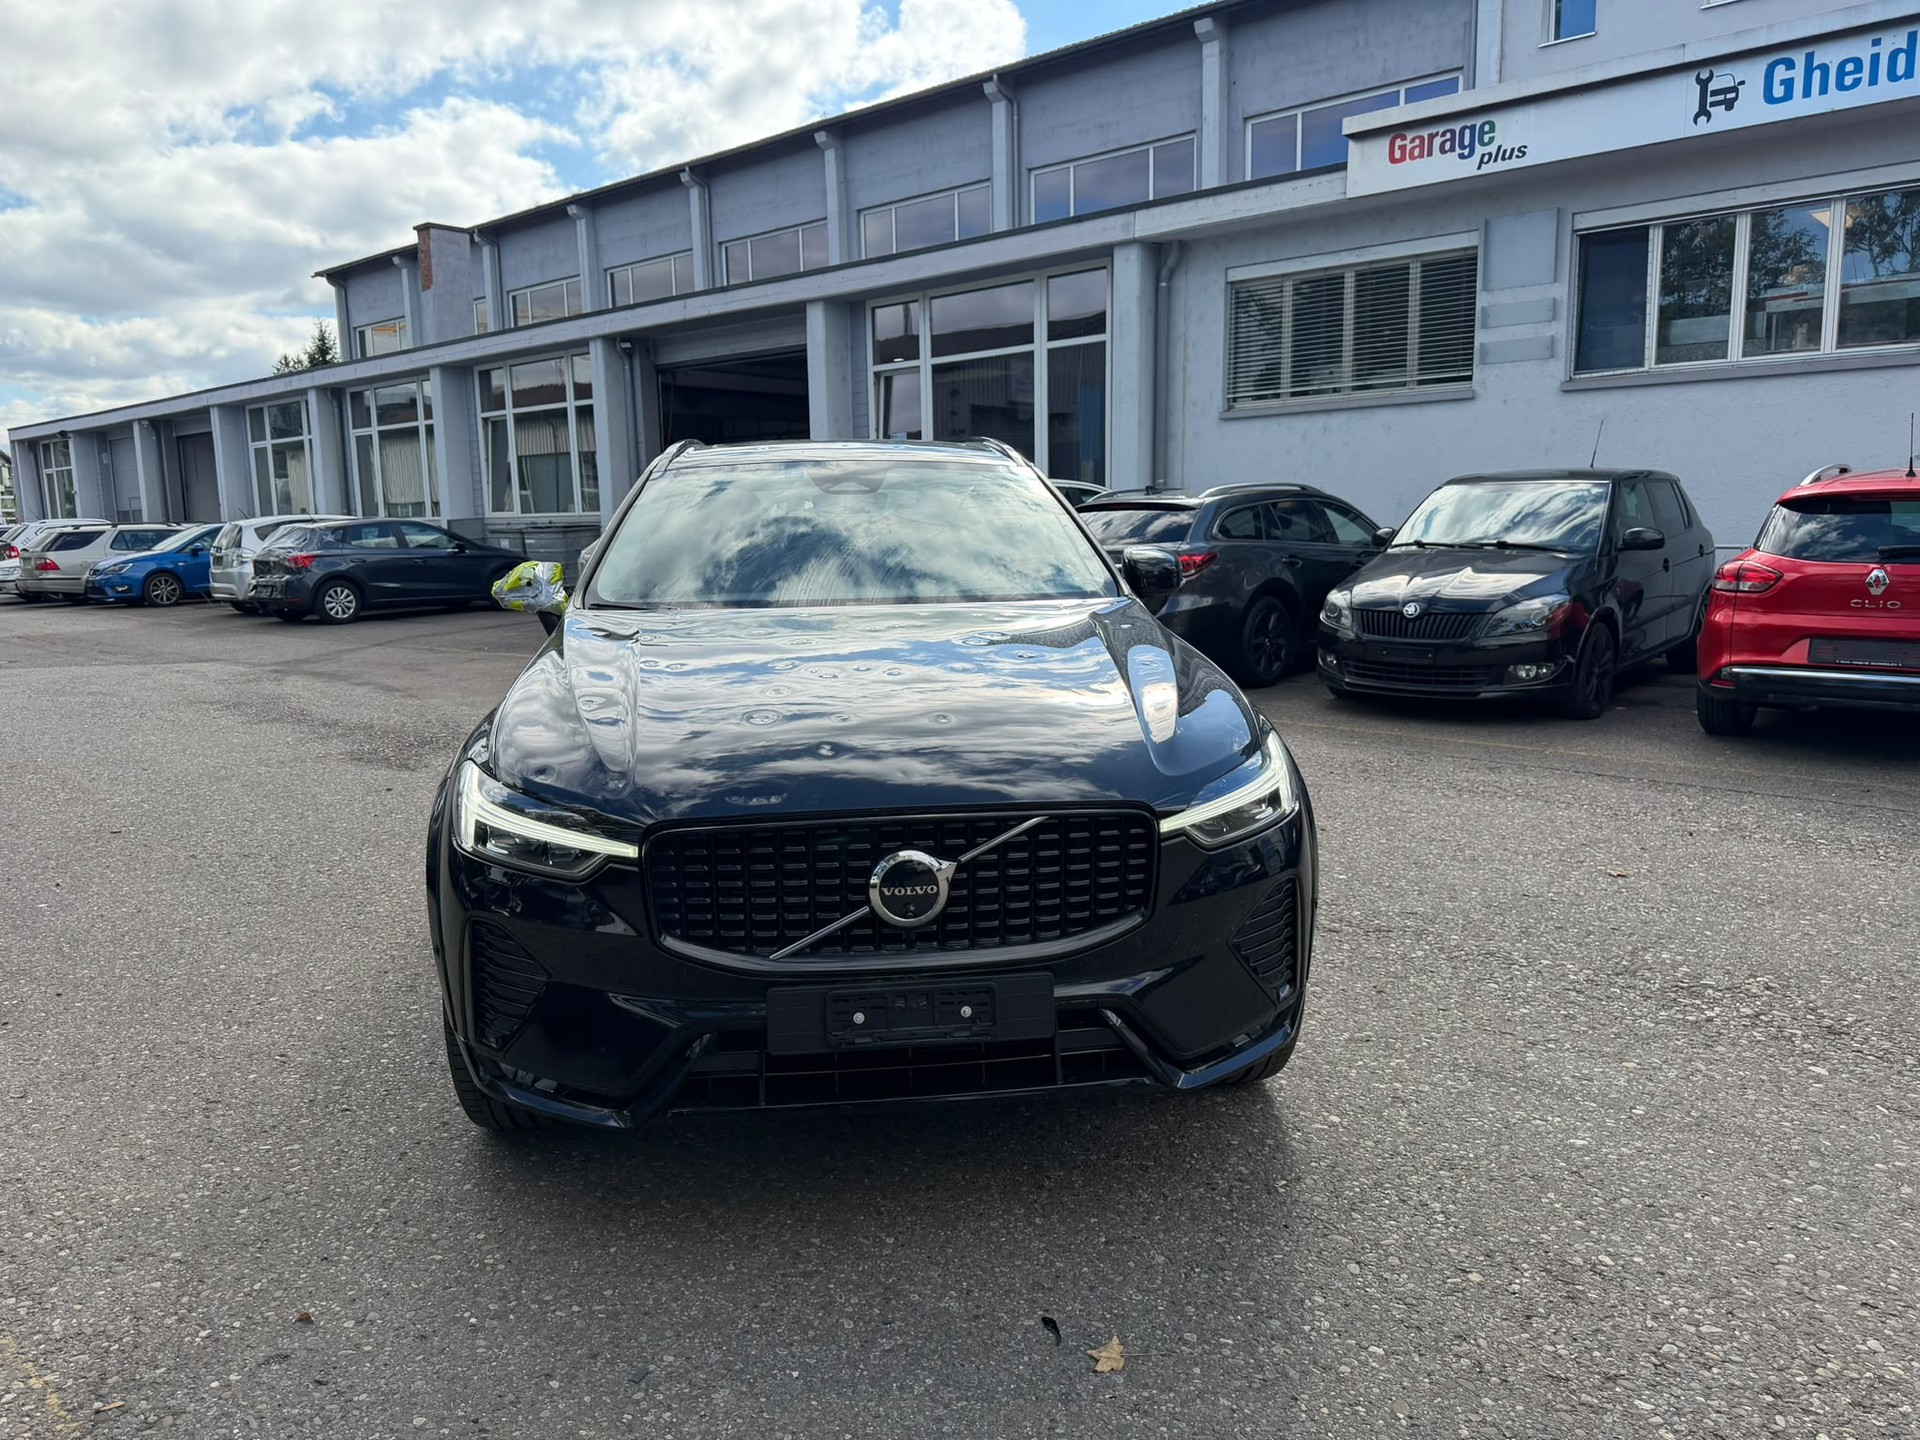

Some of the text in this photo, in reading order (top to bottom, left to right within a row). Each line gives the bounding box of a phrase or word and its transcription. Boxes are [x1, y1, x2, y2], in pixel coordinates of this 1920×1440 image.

[1763, 30, 1919, 105] Gheid
[1388, 119, 1496, 165] Garage
[1476, 144, 1529, 171] plus
[1850, 598, 1901, 609] CLIO
[881, 885, 938, 896] VOLVO
